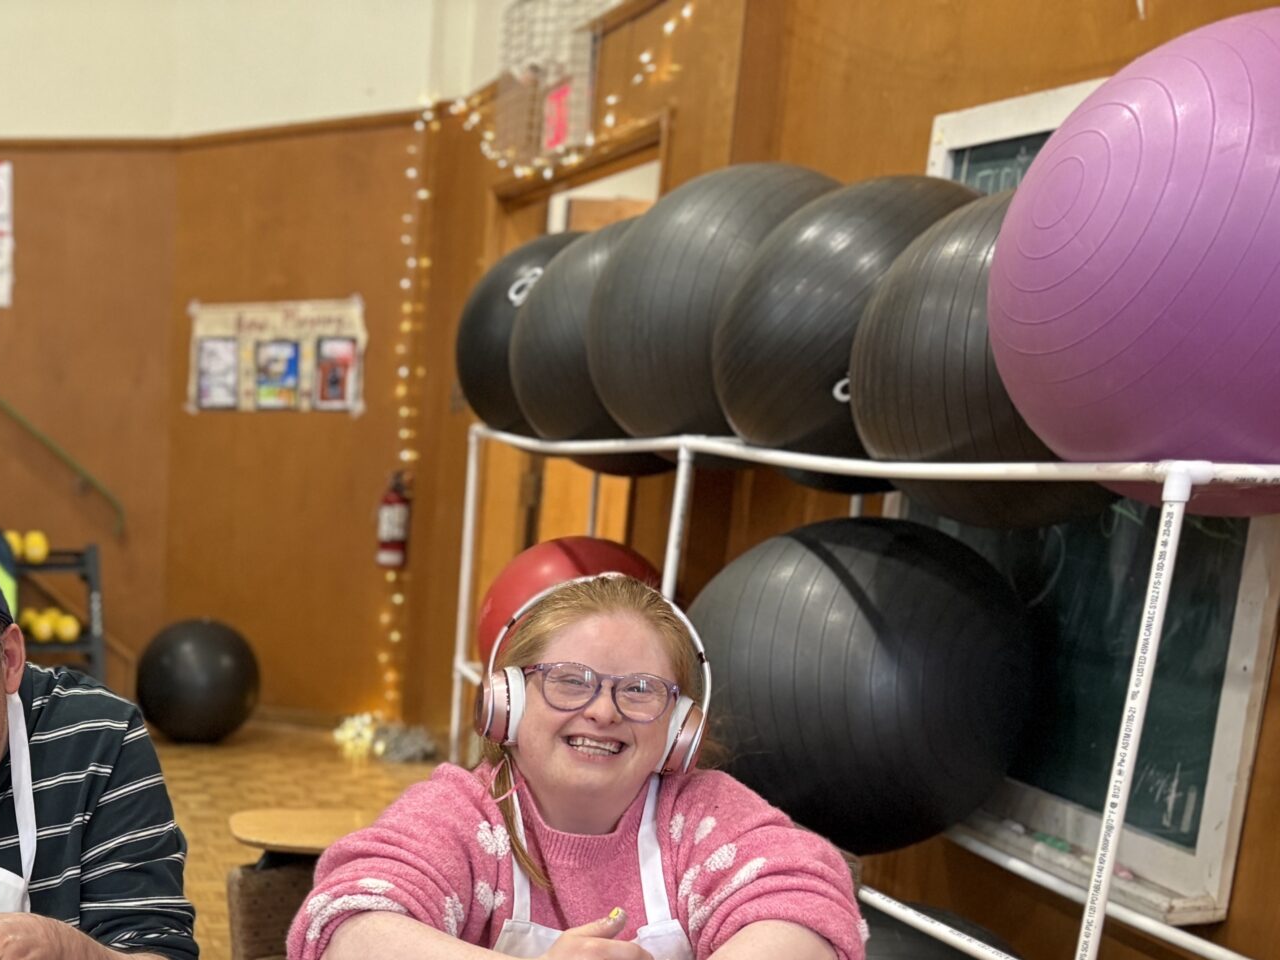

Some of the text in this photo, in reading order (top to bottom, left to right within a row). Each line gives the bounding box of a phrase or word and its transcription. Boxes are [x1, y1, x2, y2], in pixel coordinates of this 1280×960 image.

[1135, 655, 1146, 677] LISTED
[1121, 732, 1130, 750] ASTM
[1098, 851, 1107, 865] KPA
[1095, 864, 1104, 878] 4140
[1090, 878, 1102, 905] POTABLE
[1088, 904, 1096, 918] 1120
[1085, 918, 1094, 931] PVC
